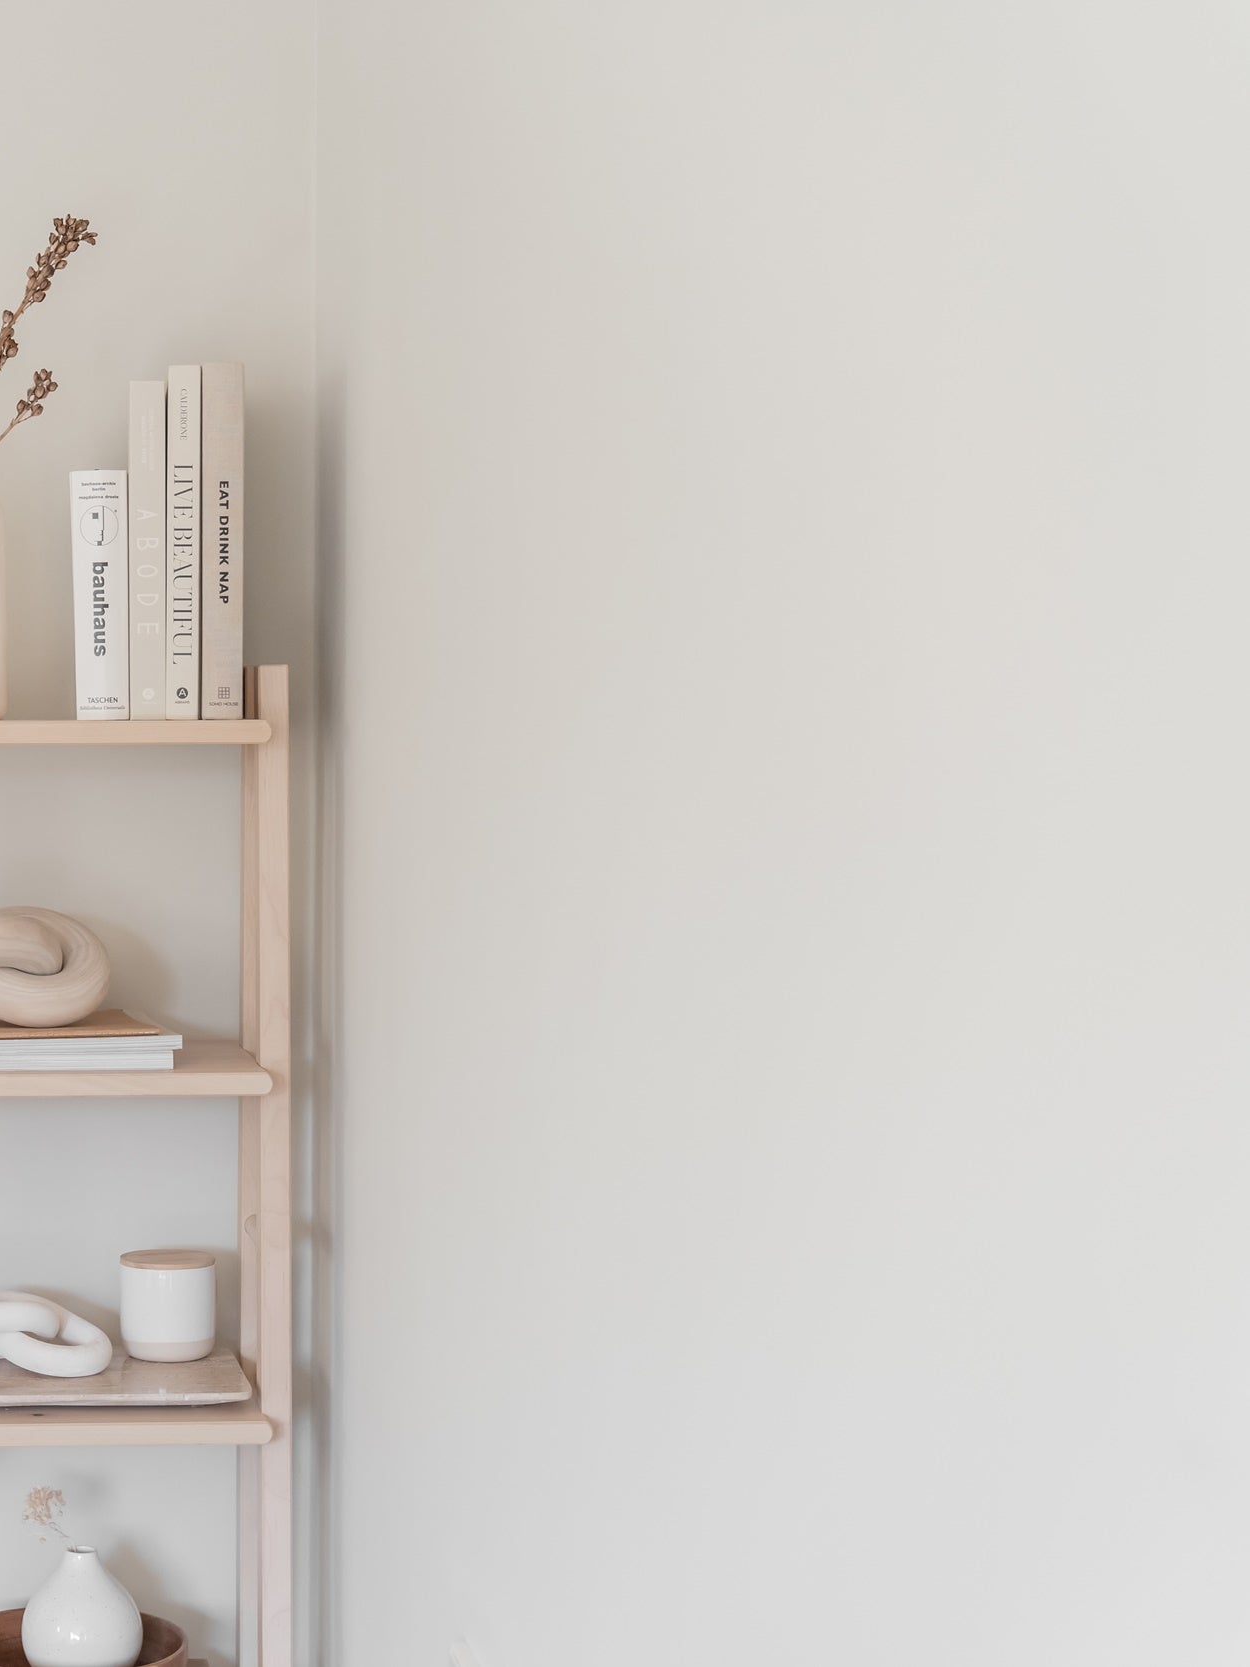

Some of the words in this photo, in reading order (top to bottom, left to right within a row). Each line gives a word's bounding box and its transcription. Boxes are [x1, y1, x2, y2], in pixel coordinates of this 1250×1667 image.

[180, 388, 188, 440] CALDERONE
[173, 464, 193, 518] LIVE
[219, 480, 229, 510] EAT
[219, 515, 229, 566] DRINK
[136, 509, 159, 635] ABODE
[173, 528, 193, 664] BEAUTIFUL
[219, 571, 229, 604] NAP
[92, 561, 109, 657] bauhaus
[87, 696, 118, 704] TASCHEN
